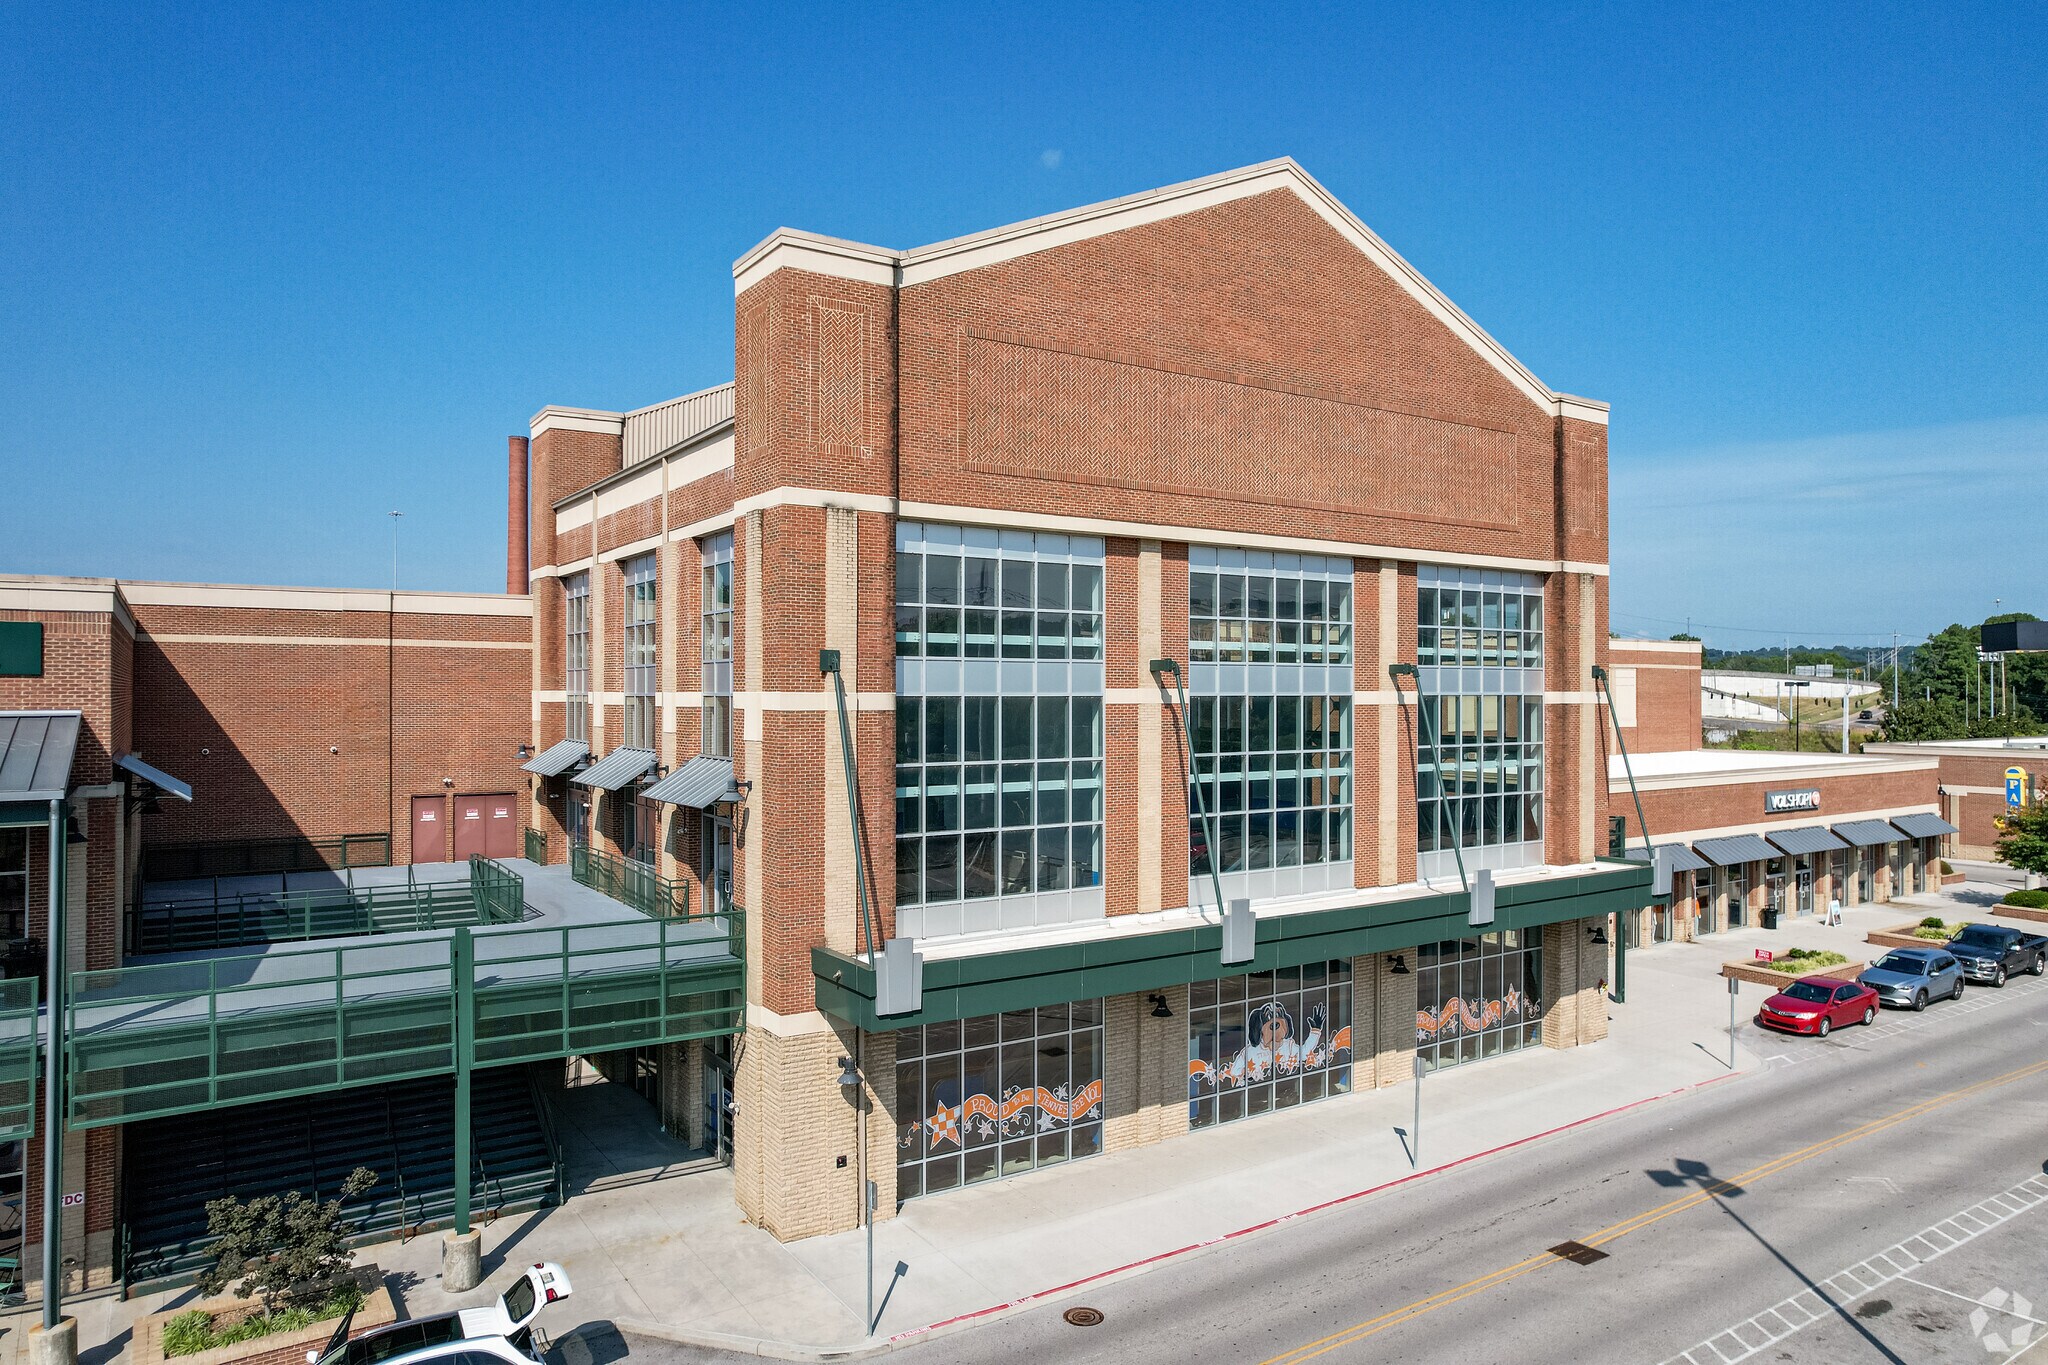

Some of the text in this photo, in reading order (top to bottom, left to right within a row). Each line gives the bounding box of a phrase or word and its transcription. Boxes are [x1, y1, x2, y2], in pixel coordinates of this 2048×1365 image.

[1771, 793, 1810, 808] VOLSHOP
[971, 1098, 1010, 1116] PROUD
[1041, 1094, 1085, 1116] TENNESSEE
[1083, 1085, 1102, 1103] VOL
